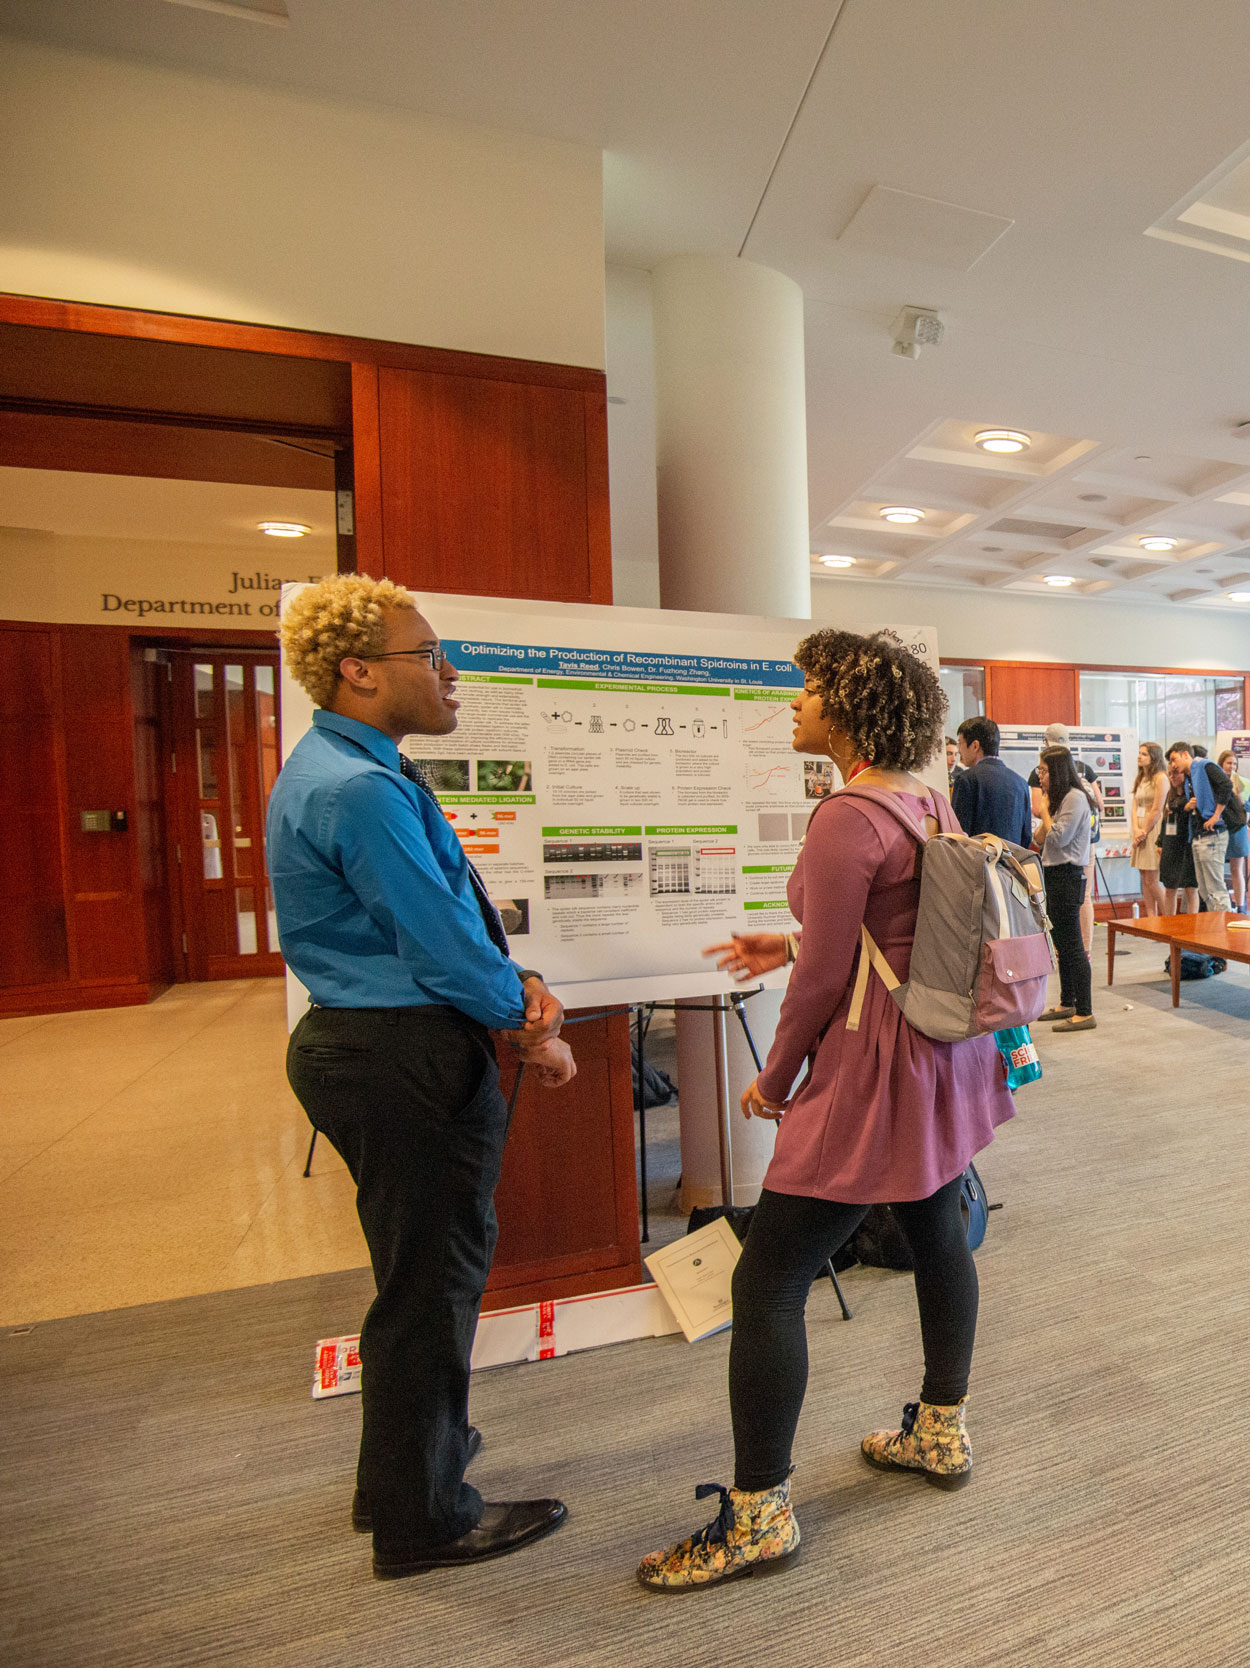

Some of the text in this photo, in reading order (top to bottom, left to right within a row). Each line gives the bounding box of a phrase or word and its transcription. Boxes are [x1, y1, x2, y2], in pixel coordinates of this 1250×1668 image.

[228, 572, 297, 593] Julia
[101, 593, 281, 617] Department of
[461, 643, 792, 672] Optimizing the Production of Recombinant Spidroins in E. coli
[559, 661, 578, 670] Tavis
[602, 663, 620, 671] Chris
[622, 665, 646, 673] Bowen,
[659, 667, 687, 676] Fuzhong
[595, 683, 644, 692] EXPERIMENTAL
[1013, 1055, 1031, 1068] FRI
